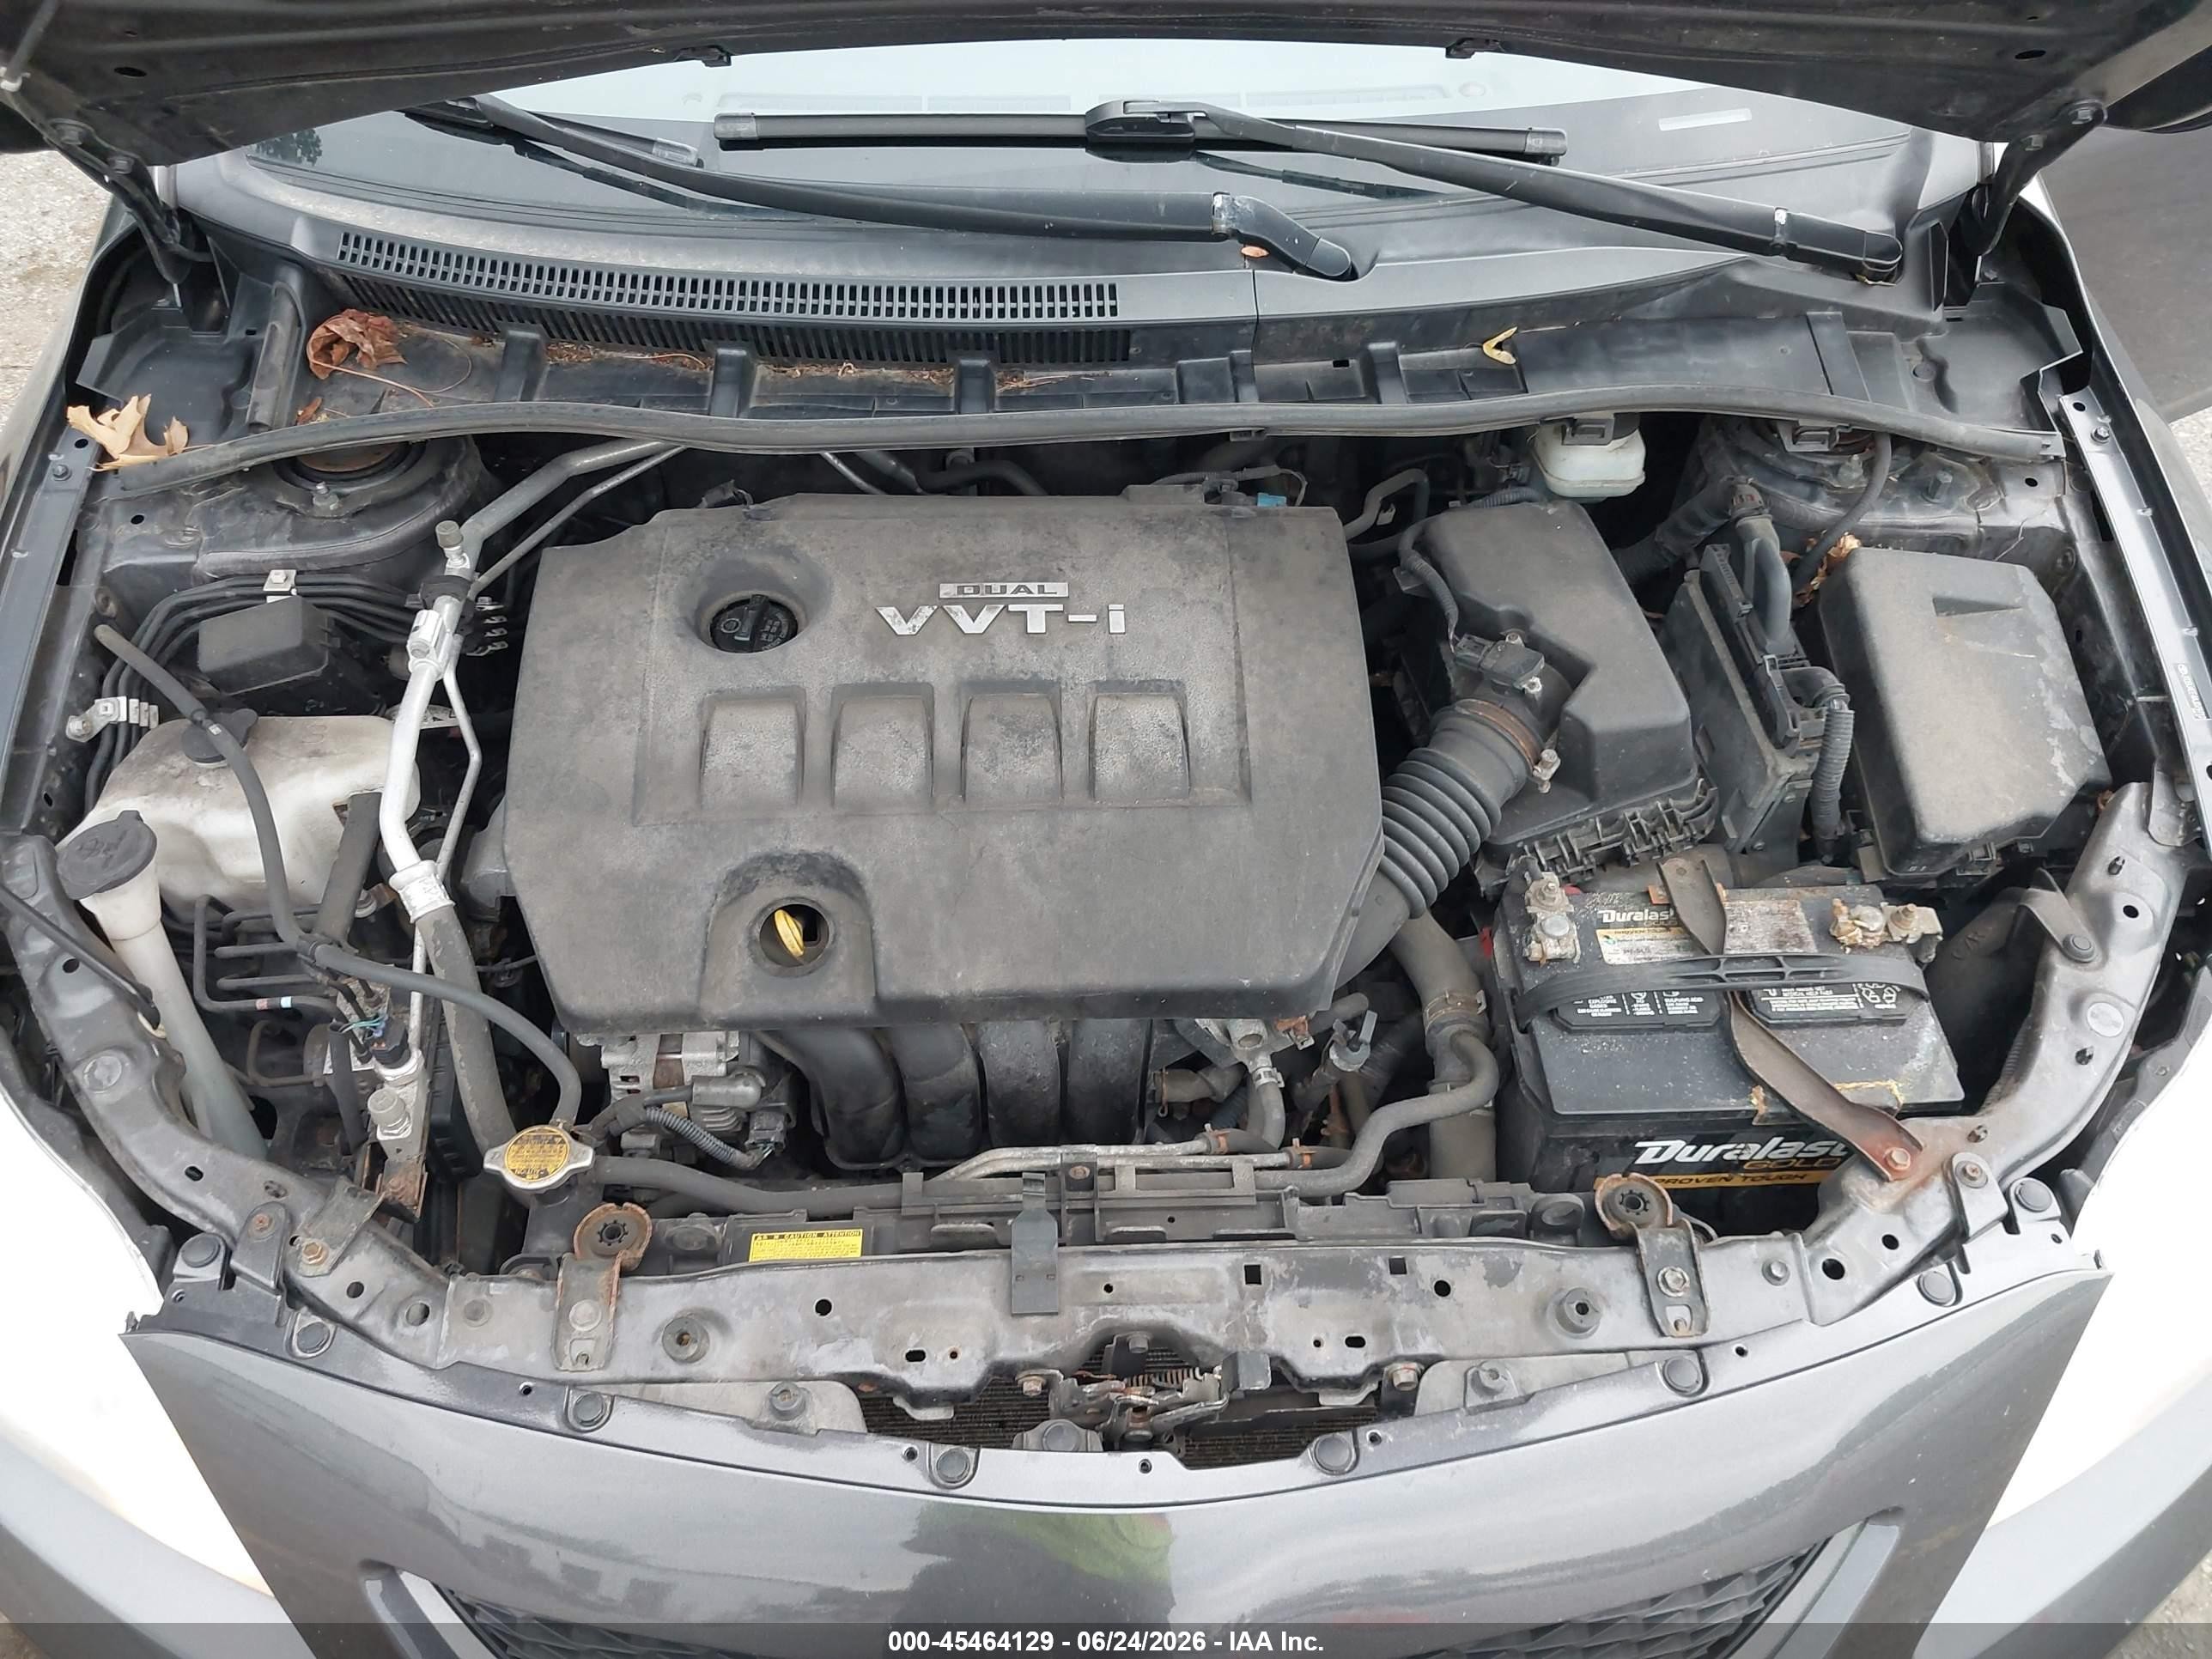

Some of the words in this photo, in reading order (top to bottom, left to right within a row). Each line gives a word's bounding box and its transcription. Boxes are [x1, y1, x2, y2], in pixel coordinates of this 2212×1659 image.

[956, 583, 1058, 596] DUAL
[875, 604, 1126, 636] VVT-i
[1743, 1158, 1842, 1170] GOLD
[1741, 1173, 1808, 1182] TOUGH
